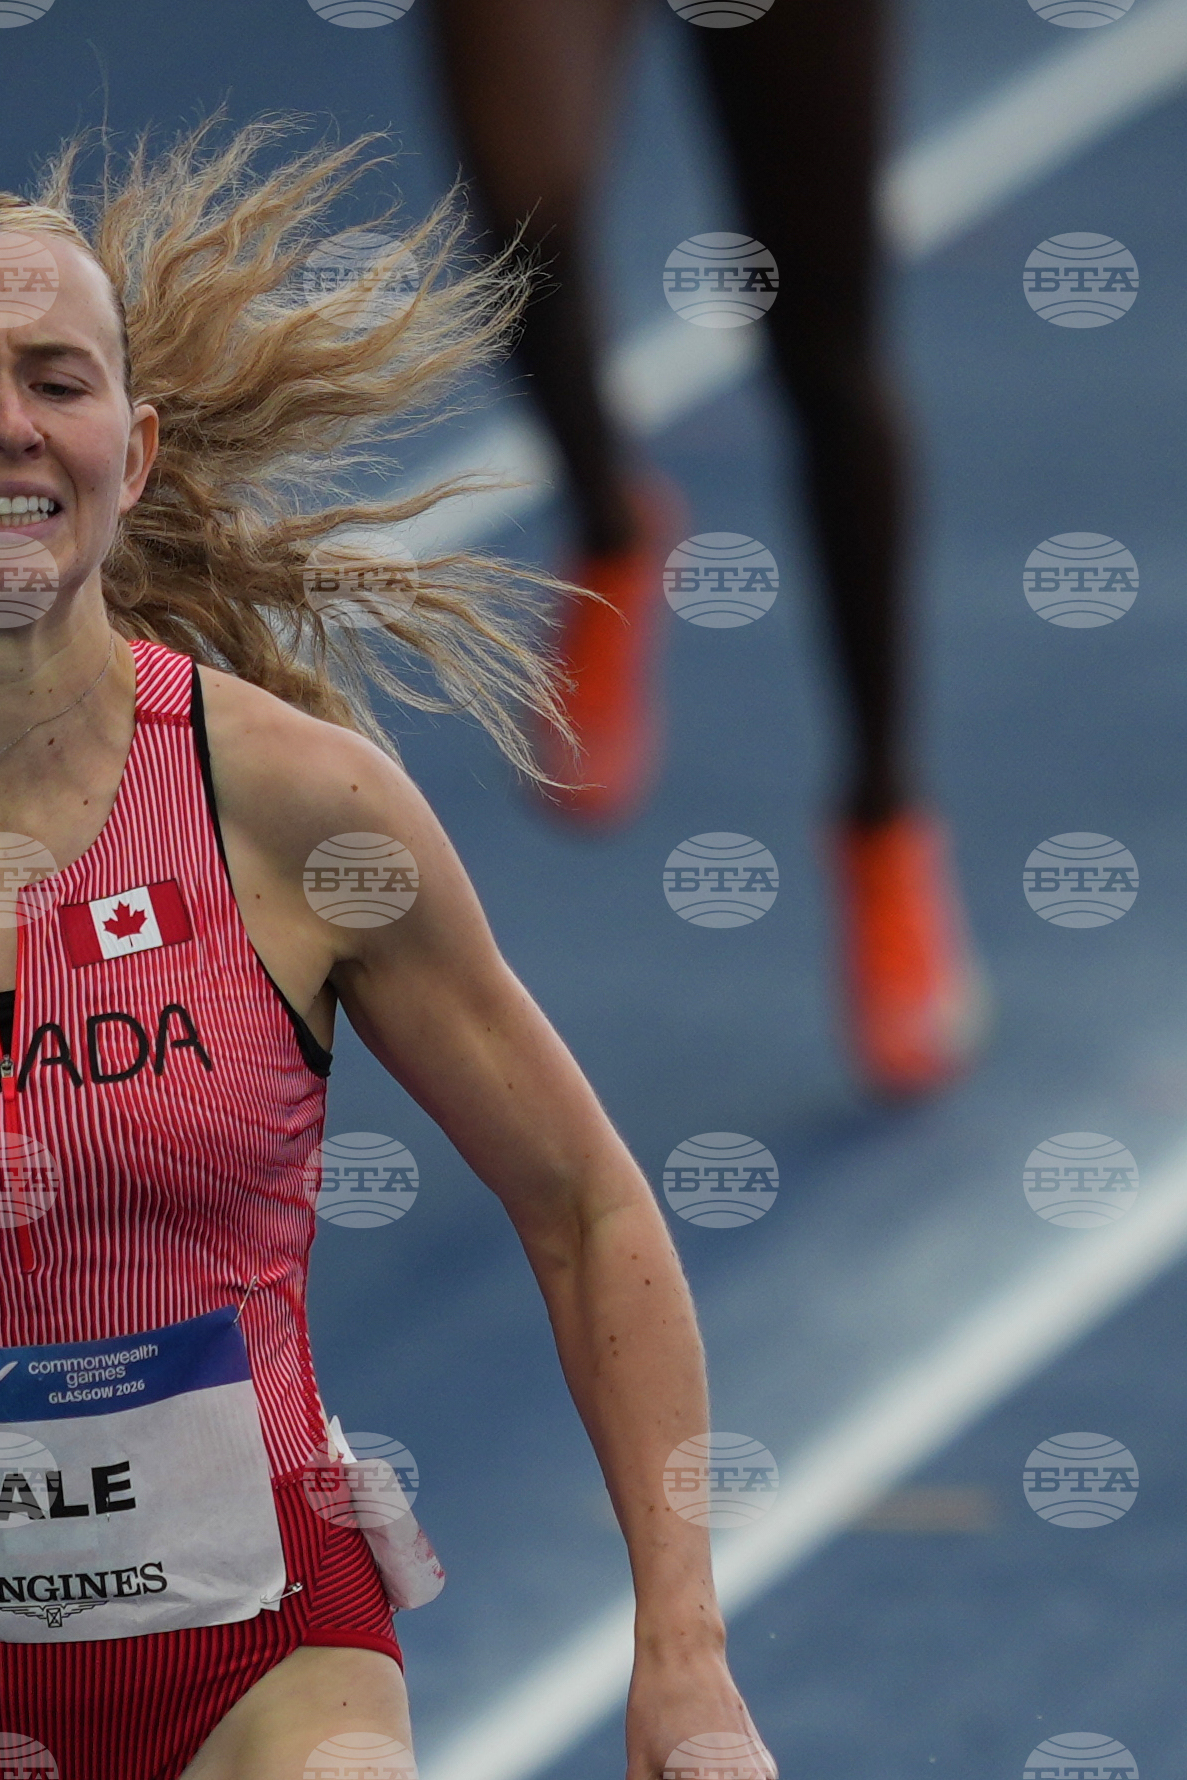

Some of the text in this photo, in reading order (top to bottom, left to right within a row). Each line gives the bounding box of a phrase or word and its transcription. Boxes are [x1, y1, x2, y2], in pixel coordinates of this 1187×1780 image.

[28, 1344, 159, 1375] commonwealth
[66, 1366, 126, 1388] games
[48, 1379, 145, 1404] GLASGOW 2026
